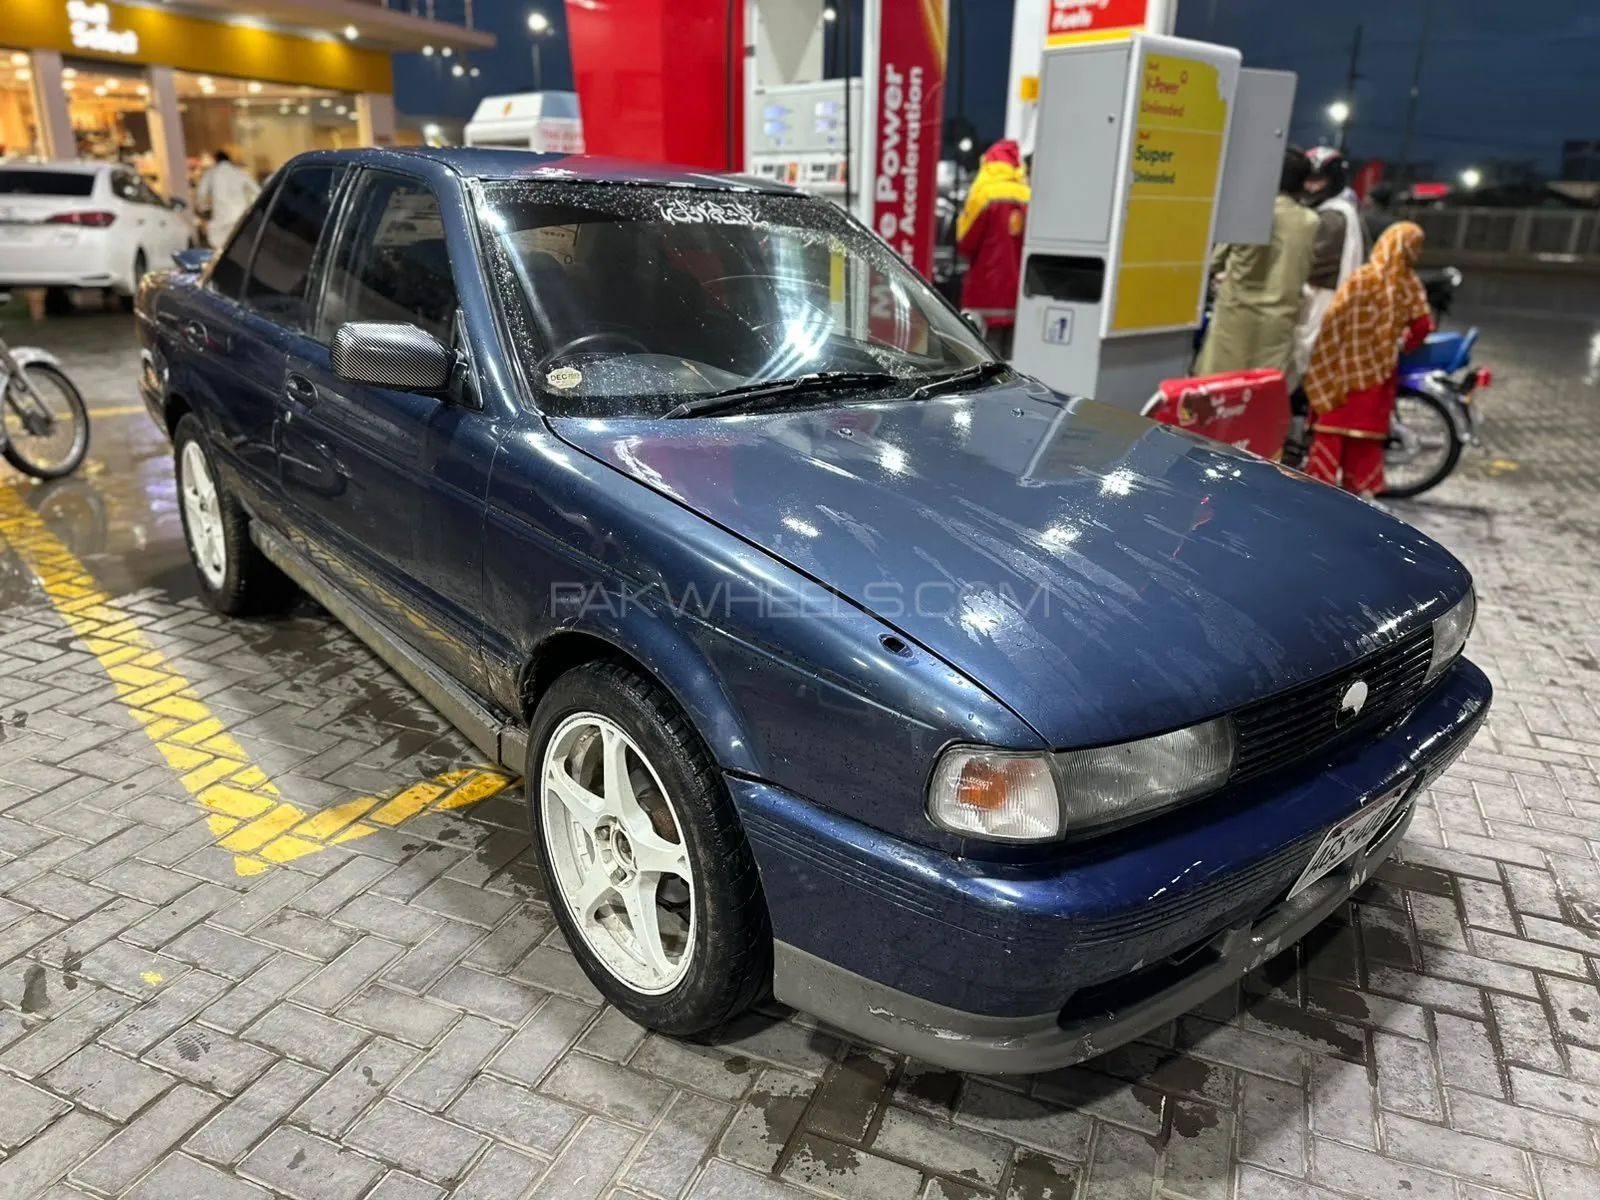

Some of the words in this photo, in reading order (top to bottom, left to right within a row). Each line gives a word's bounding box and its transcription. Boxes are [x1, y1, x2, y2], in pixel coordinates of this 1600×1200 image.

[875, 63, 903, 202] Power
[900, 66, 923, 236] Acceleration
[1134, 144, 1173, 165] Super
[550, 373, 568, 382] DEC
